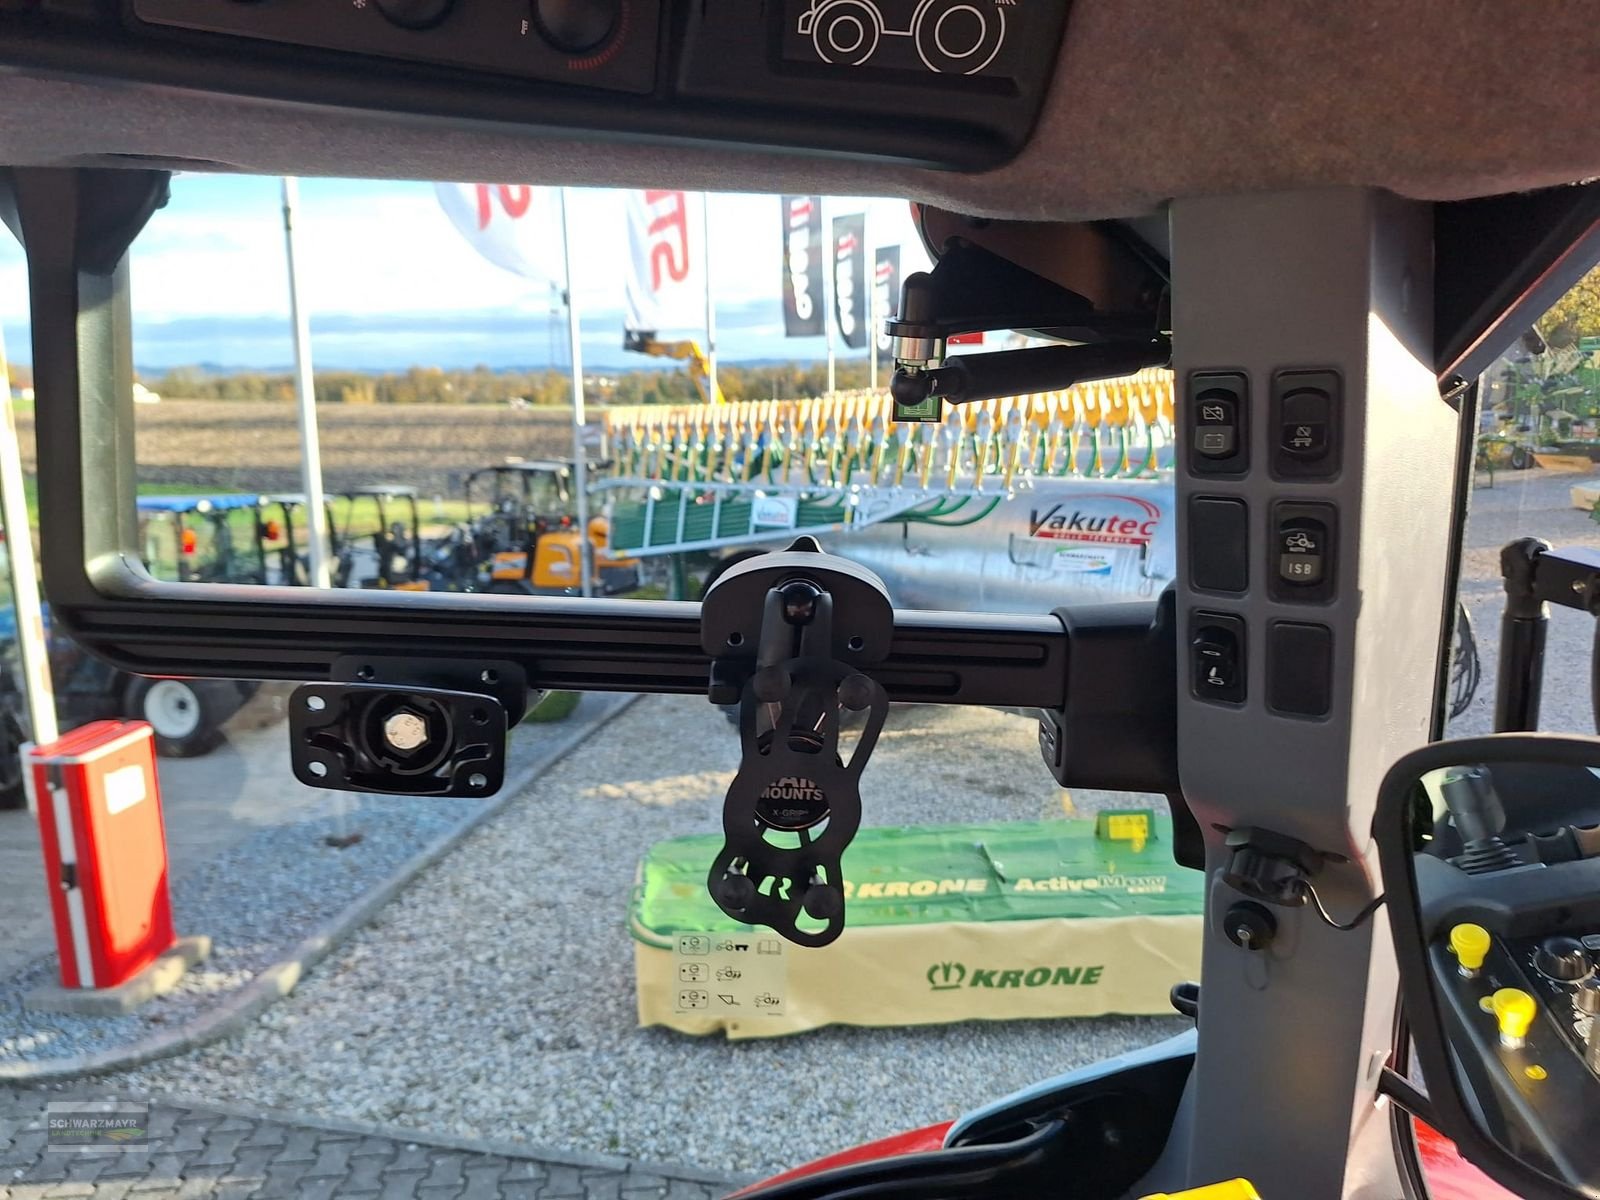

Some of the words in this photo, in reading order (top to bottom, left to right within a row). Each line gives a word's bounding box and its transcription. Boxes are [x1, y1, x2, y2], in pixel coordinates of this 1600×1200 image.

[1029, 503, 1158, 537] Vakutec
[1288, 563, 1312, 575] ISB
[857, 879, 988, 898] KRONE
[969, 965, 1105, 988] KRONE
